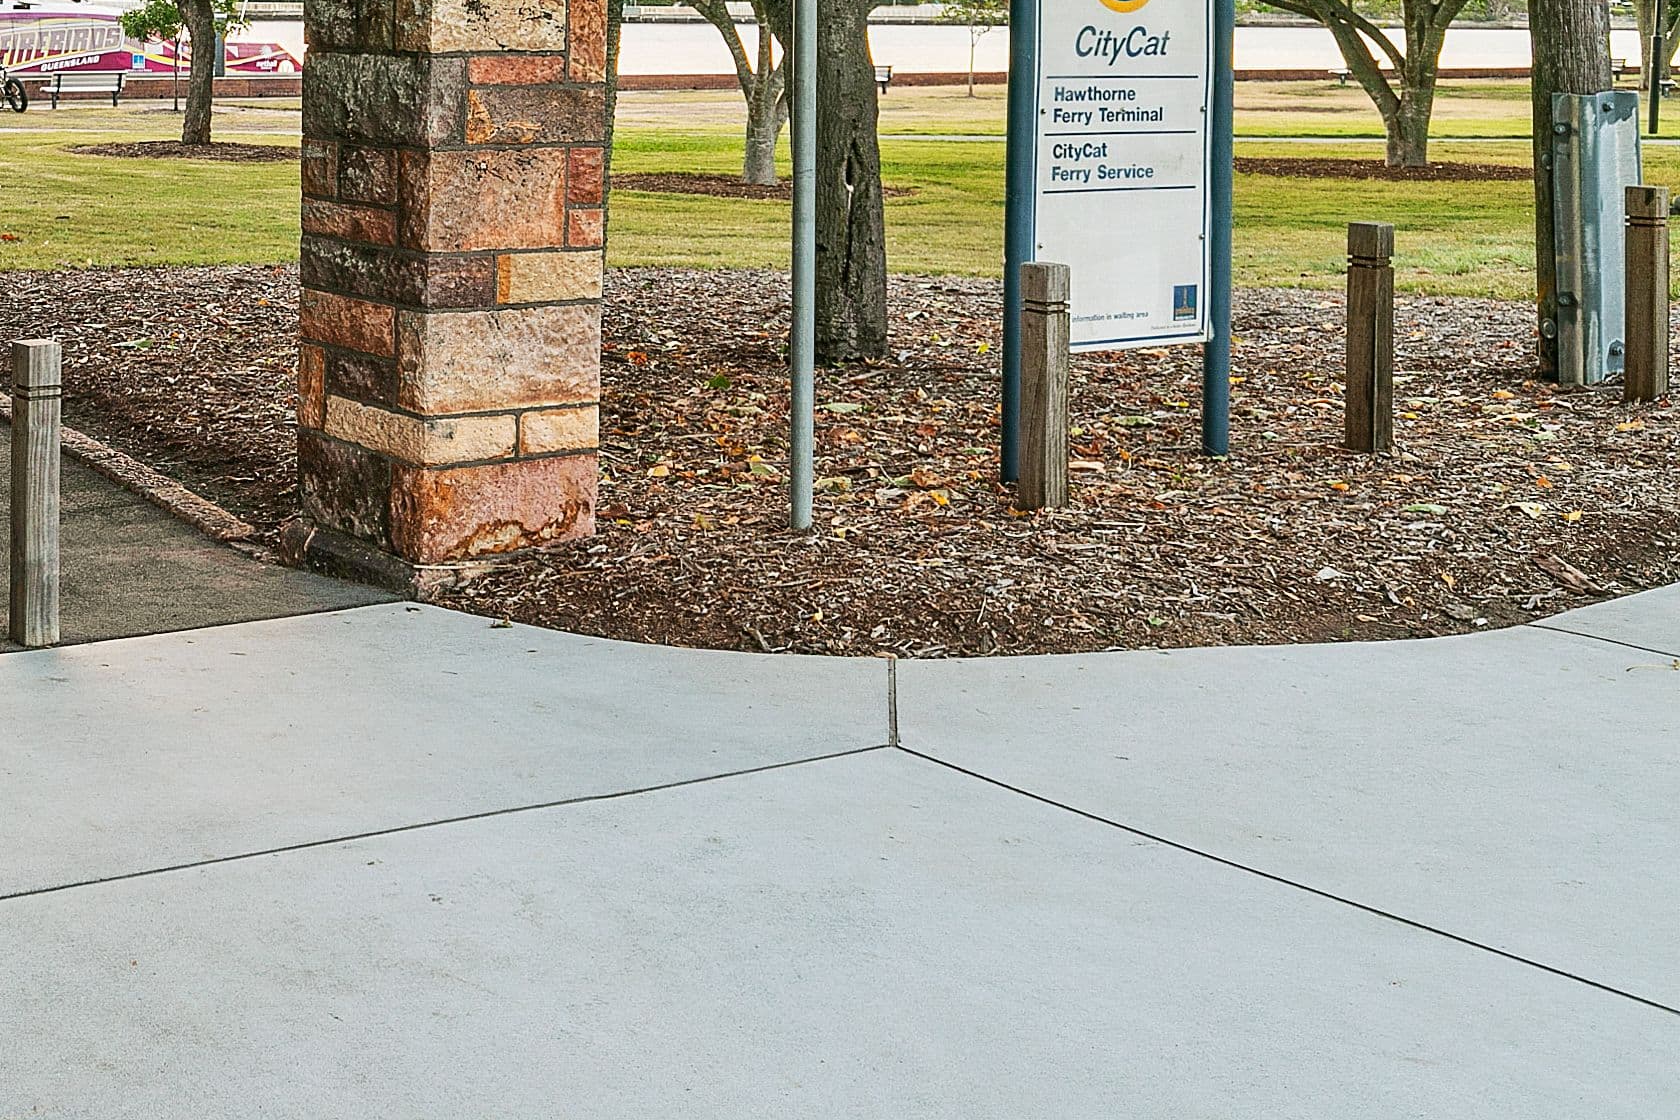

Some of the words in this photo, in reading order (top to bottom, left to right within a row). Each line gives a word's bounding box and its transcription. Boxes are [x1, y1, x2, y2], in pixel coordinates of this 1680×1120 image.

[1075, 24, 1171, 67] CityCat
[39, 54, 101, 72] QUEENSLAND
[1053, 86, 1136, 102] Hawthorne
[1053, 107, 1093, 126] Ferry
[1098, 106, 1164, 123] Terminal
[1052, 142, 1108, 162] CityCat
[1051, 165, 1092, 183] Ferry
[1097, 163, 1155, 180] Service
[1106, 312, 1113, 320] in
[1114, 311, 1135, 321] waiting
[1135, 310, 1149, 319] area
